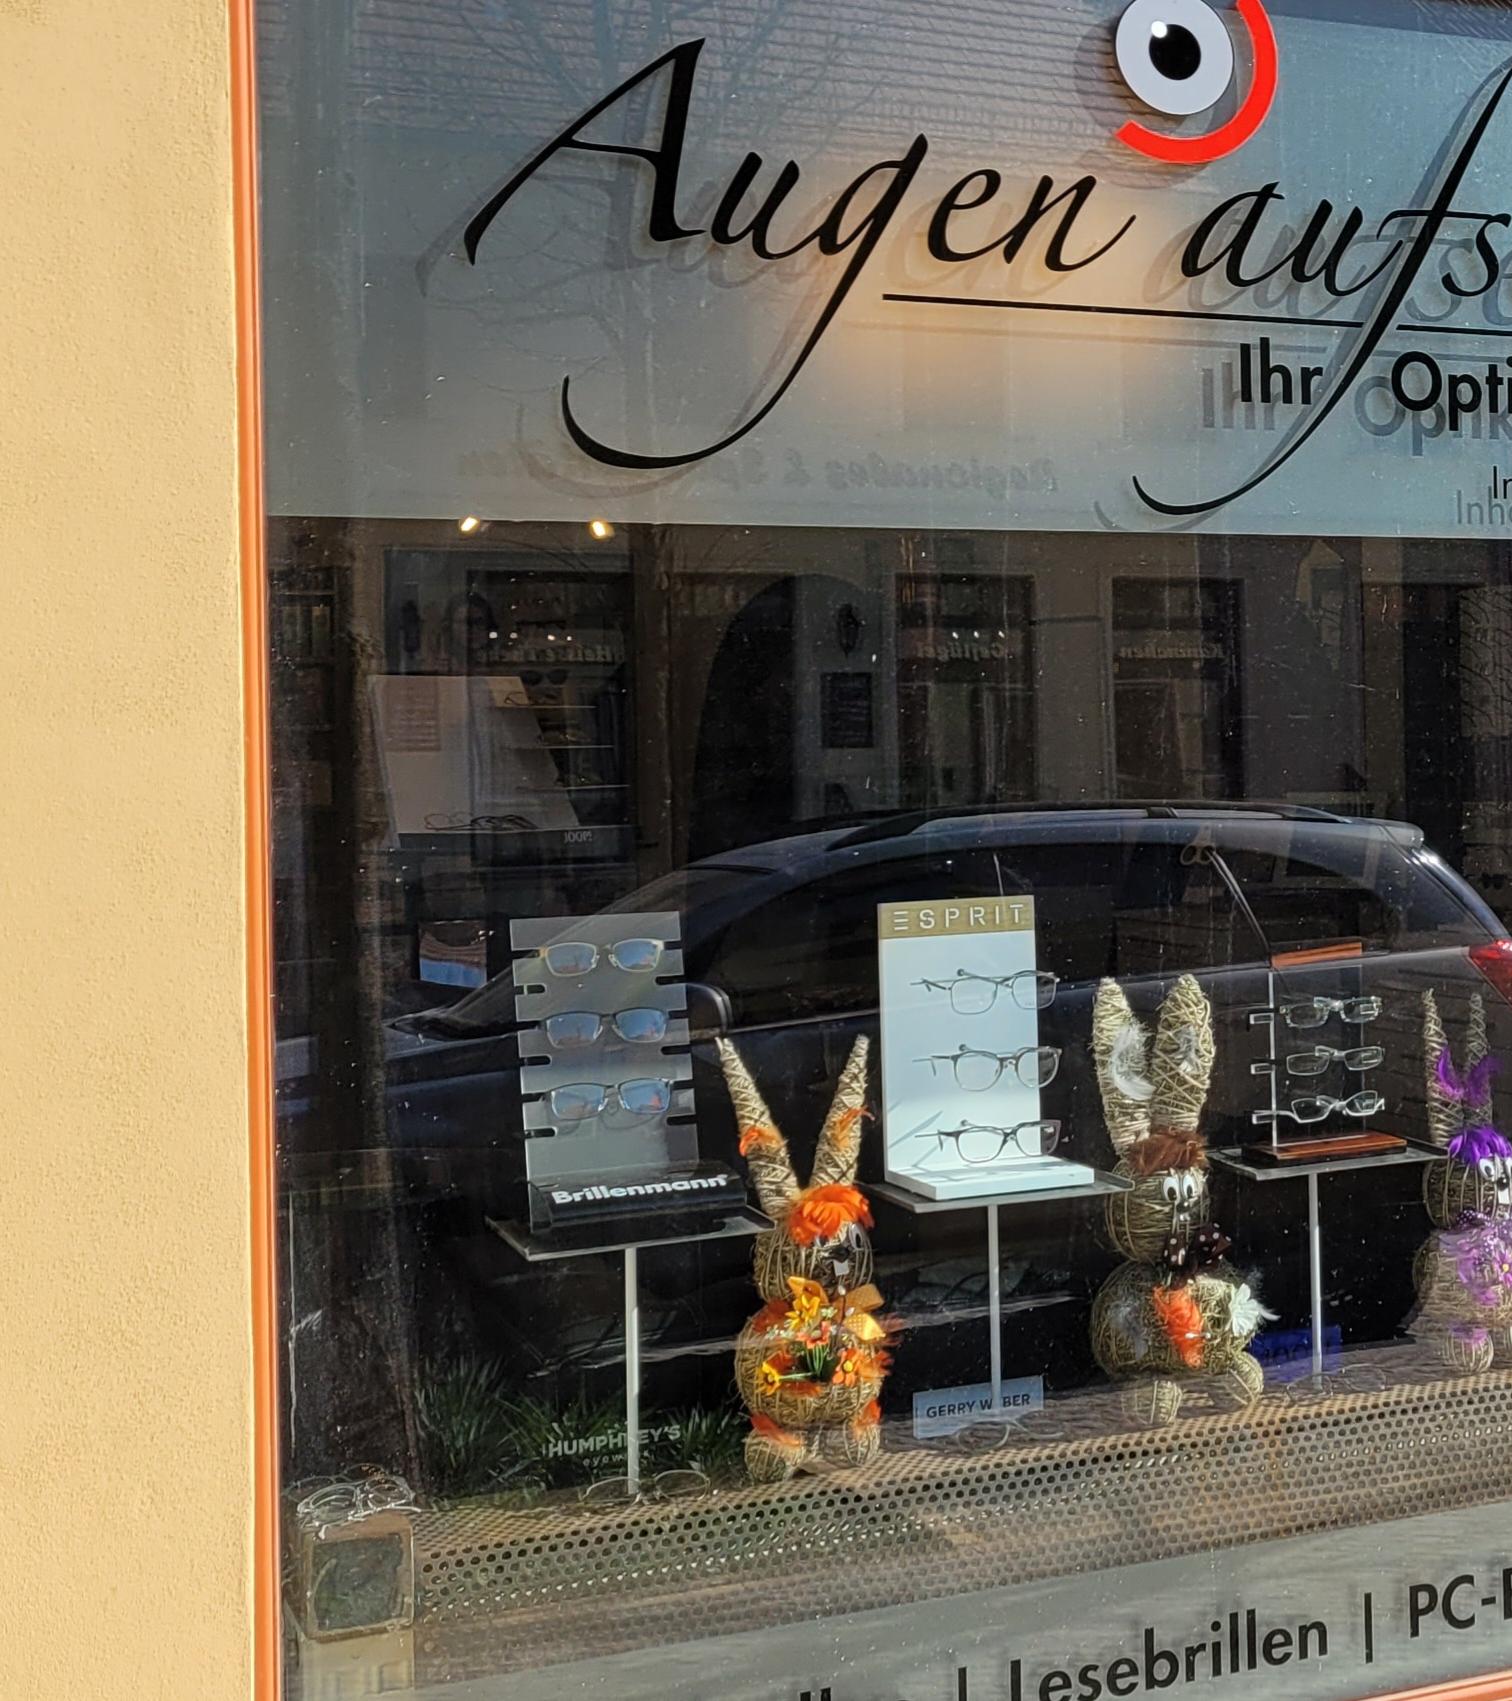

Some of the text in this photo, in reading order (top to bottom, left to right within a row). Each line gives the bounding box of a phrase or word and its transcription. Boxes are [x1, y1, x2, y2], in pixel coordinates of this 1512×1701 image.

[464, 37, 1135, 468] Augen
[1240, 337, 1323, 406] Ihr
[893, 904, 1024, 931] ESPRIT
[551, 1174, 728, 1205] Brillenmann
[926, 1393, 1031, 1419] GERRY WBER
